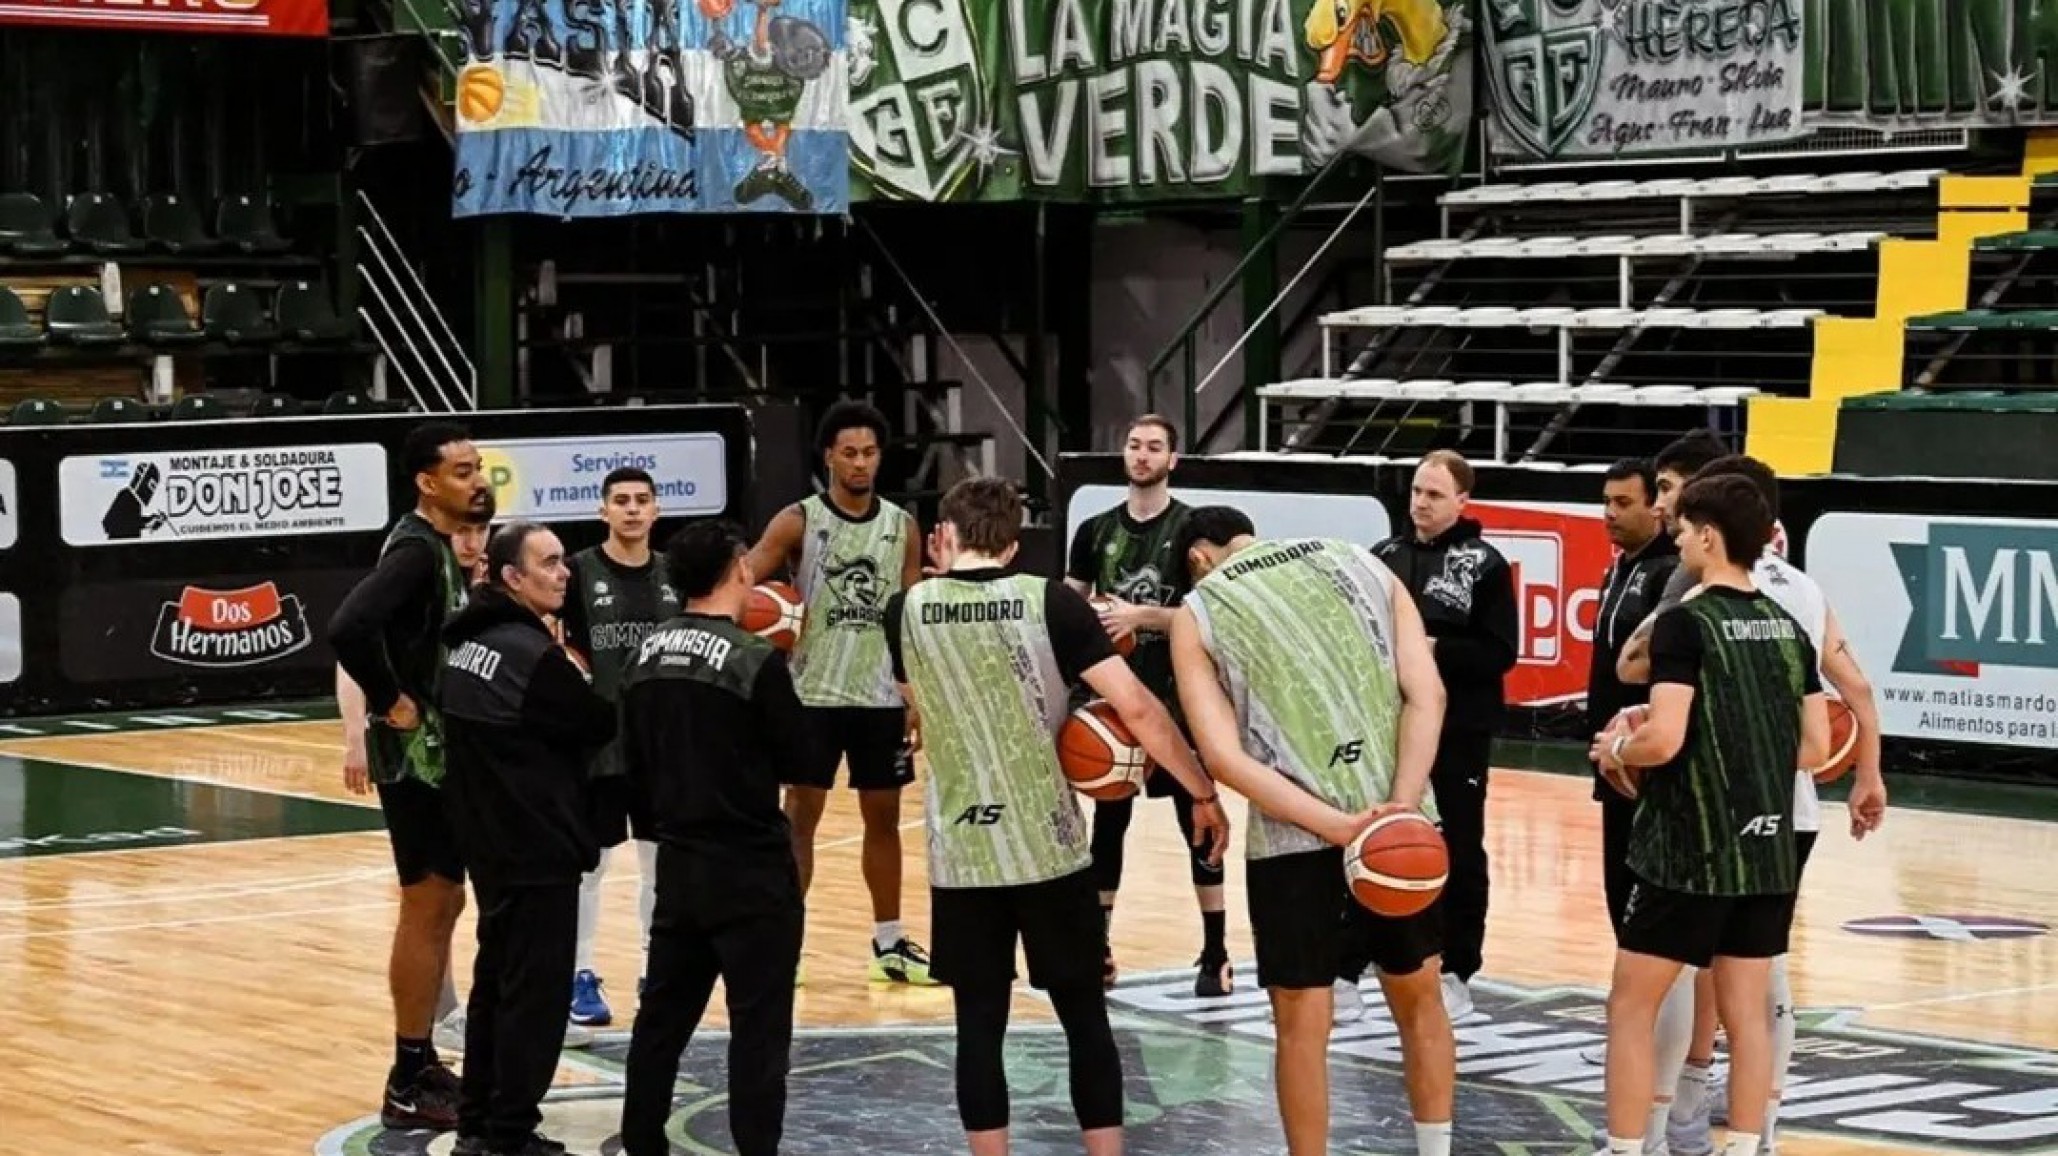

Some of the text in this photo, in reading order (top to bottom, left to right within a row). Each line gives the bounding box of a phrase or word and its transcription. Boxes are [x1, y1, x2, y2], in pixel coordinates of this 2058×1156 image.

[1008, 0, 1299, 85] LA MAGIA
[1610, 72, 1703, 102] Mauro
[1018, 60, 1303, 187] VERDE
[507, 145, 702, 211] Argentina
[169, 451, 336, 470] MONTAJE & SOLDADURA
[572, 452, 657, 473] Servicios
[166, 467, 343, 520] DON JOSE
[533, 486, 545, 507] y
[180, 521, 236, 534] CUIDEMOS
[255, 519, 289, 530] MEDIO
[291, 517, 345, 528] AMBIENTE
[1222, 541, 1325, 581] COMODORO
[211, 598, 252, 624] Dos
[921, 599, 1025, 625] COMODORO
[170, 619, 293, 657] Hermanos
[1722, 618, 1796, 641] COMODORO
[638, 628, 732, 672] GIMNASIA
[1919, 711, 2004, 736] Alimentos
[2008, 721, 2047, 739] para
